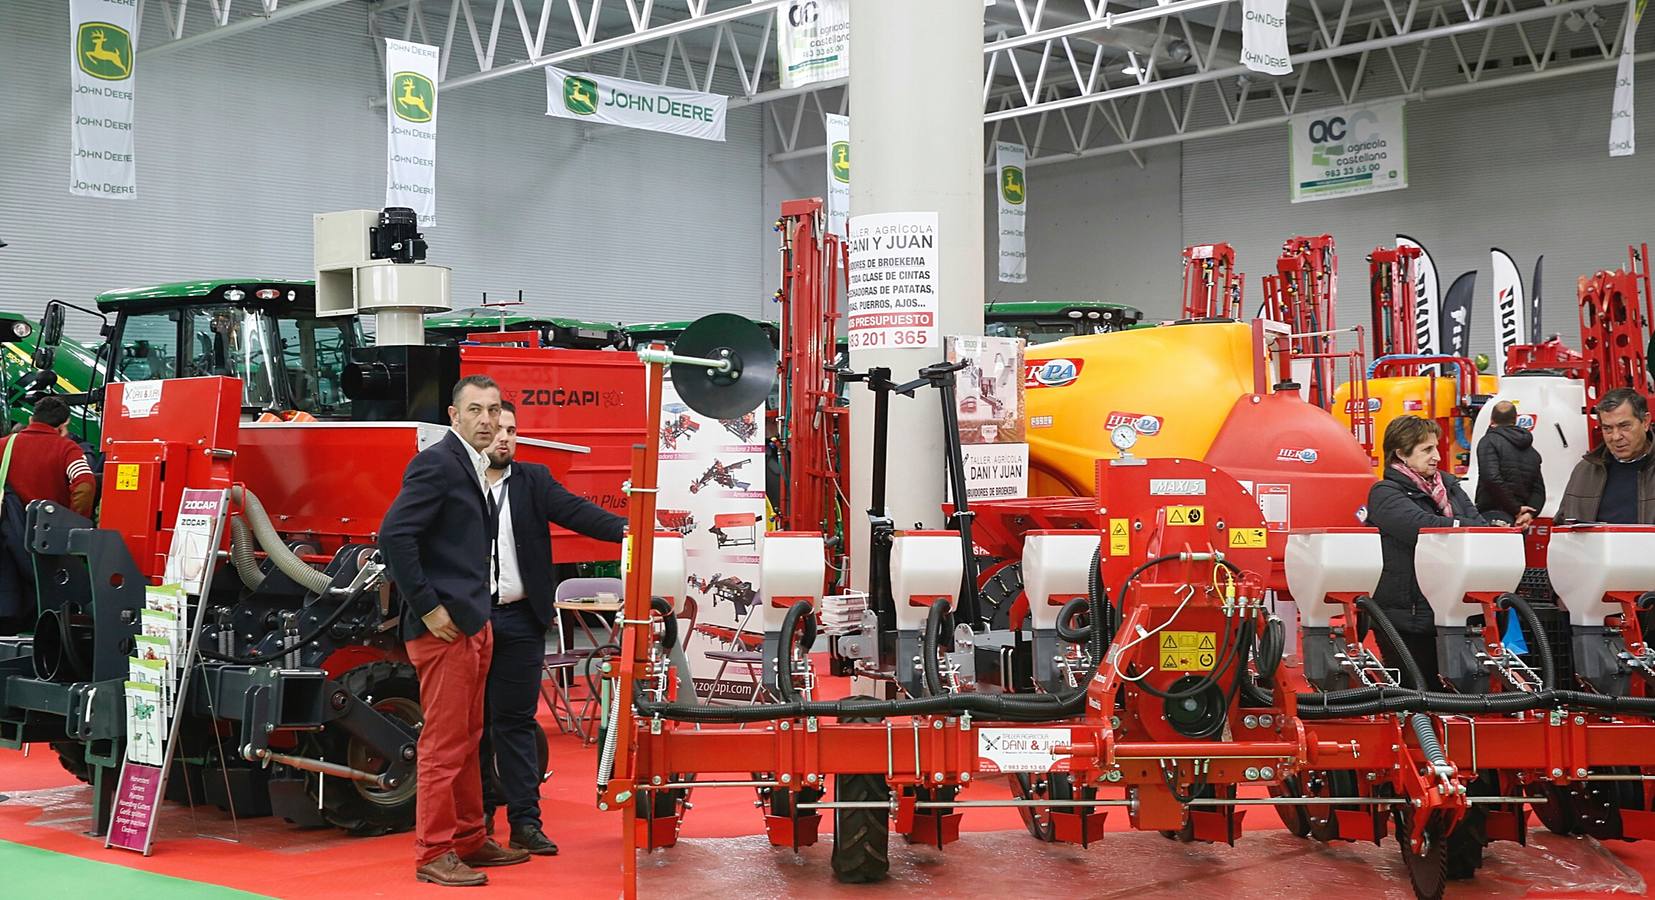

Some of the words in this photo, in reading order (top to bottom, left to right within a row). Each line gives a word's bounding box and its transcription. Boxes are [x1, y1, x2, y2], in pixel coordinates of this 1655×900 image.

[389, 43, 410, 53] JOHN
[75, 84, 102, 96] JOHN
[605, 89, 653, 113] JOHN
[657, 96, 714, 123] DEERE
[76, 116, 102, 127] JOHN
[391, 125, 411, 136] JOHN
[75, 148, 102, 159] JOHN
[1336, 151, 1387, 166] castellana
[1343, 167, 1354, 176] 33
[1368, 163, 1380, 171] 00
[73, 180, 101, 191] JOHN
[103, 183, 135, 193] DEERE
[390, 181, 412, 192] JOHN
[873, 236, 882, 250] Y
[886, 235, 933, 249] JUAN
[867, 259, 876, 268] DE
[878, 257, 925, 267] BROEKEMA
[862, 272, 883, 282] CLASE
[885, 271, 897, 280] DE
[899, 270, 931, 280] CINTAS
[880, 285, 890, 295] DE
[892, 284, 934, 295] PATATAS,
[859, 299, 893, 310] PUERROS,
[895, 298, 926, 308] AJOS...
[856, 314, 930, 328] PRESUPUESTO
[862, 331, 886, 346] 201
[893, 330, 927, 345] 365
[521, 389, 599, 407] ZOCAPI
[971, 466, 991, 480] DANI
[992, 465, 998, 479] Y
[1000, 465, 1022, 478] JUAN
[989, 487, 995, 496] DE
[1156, 480, 1191, 492] MAXI
[184, 500, 218, 510] ZOCAPI
[601, 494, 627, 508] Plus
[181, 518, 208, 527] ZOCAPI
[1002, 740, 1027, 751] DANI
[1030, 740, 1040, 751] &
